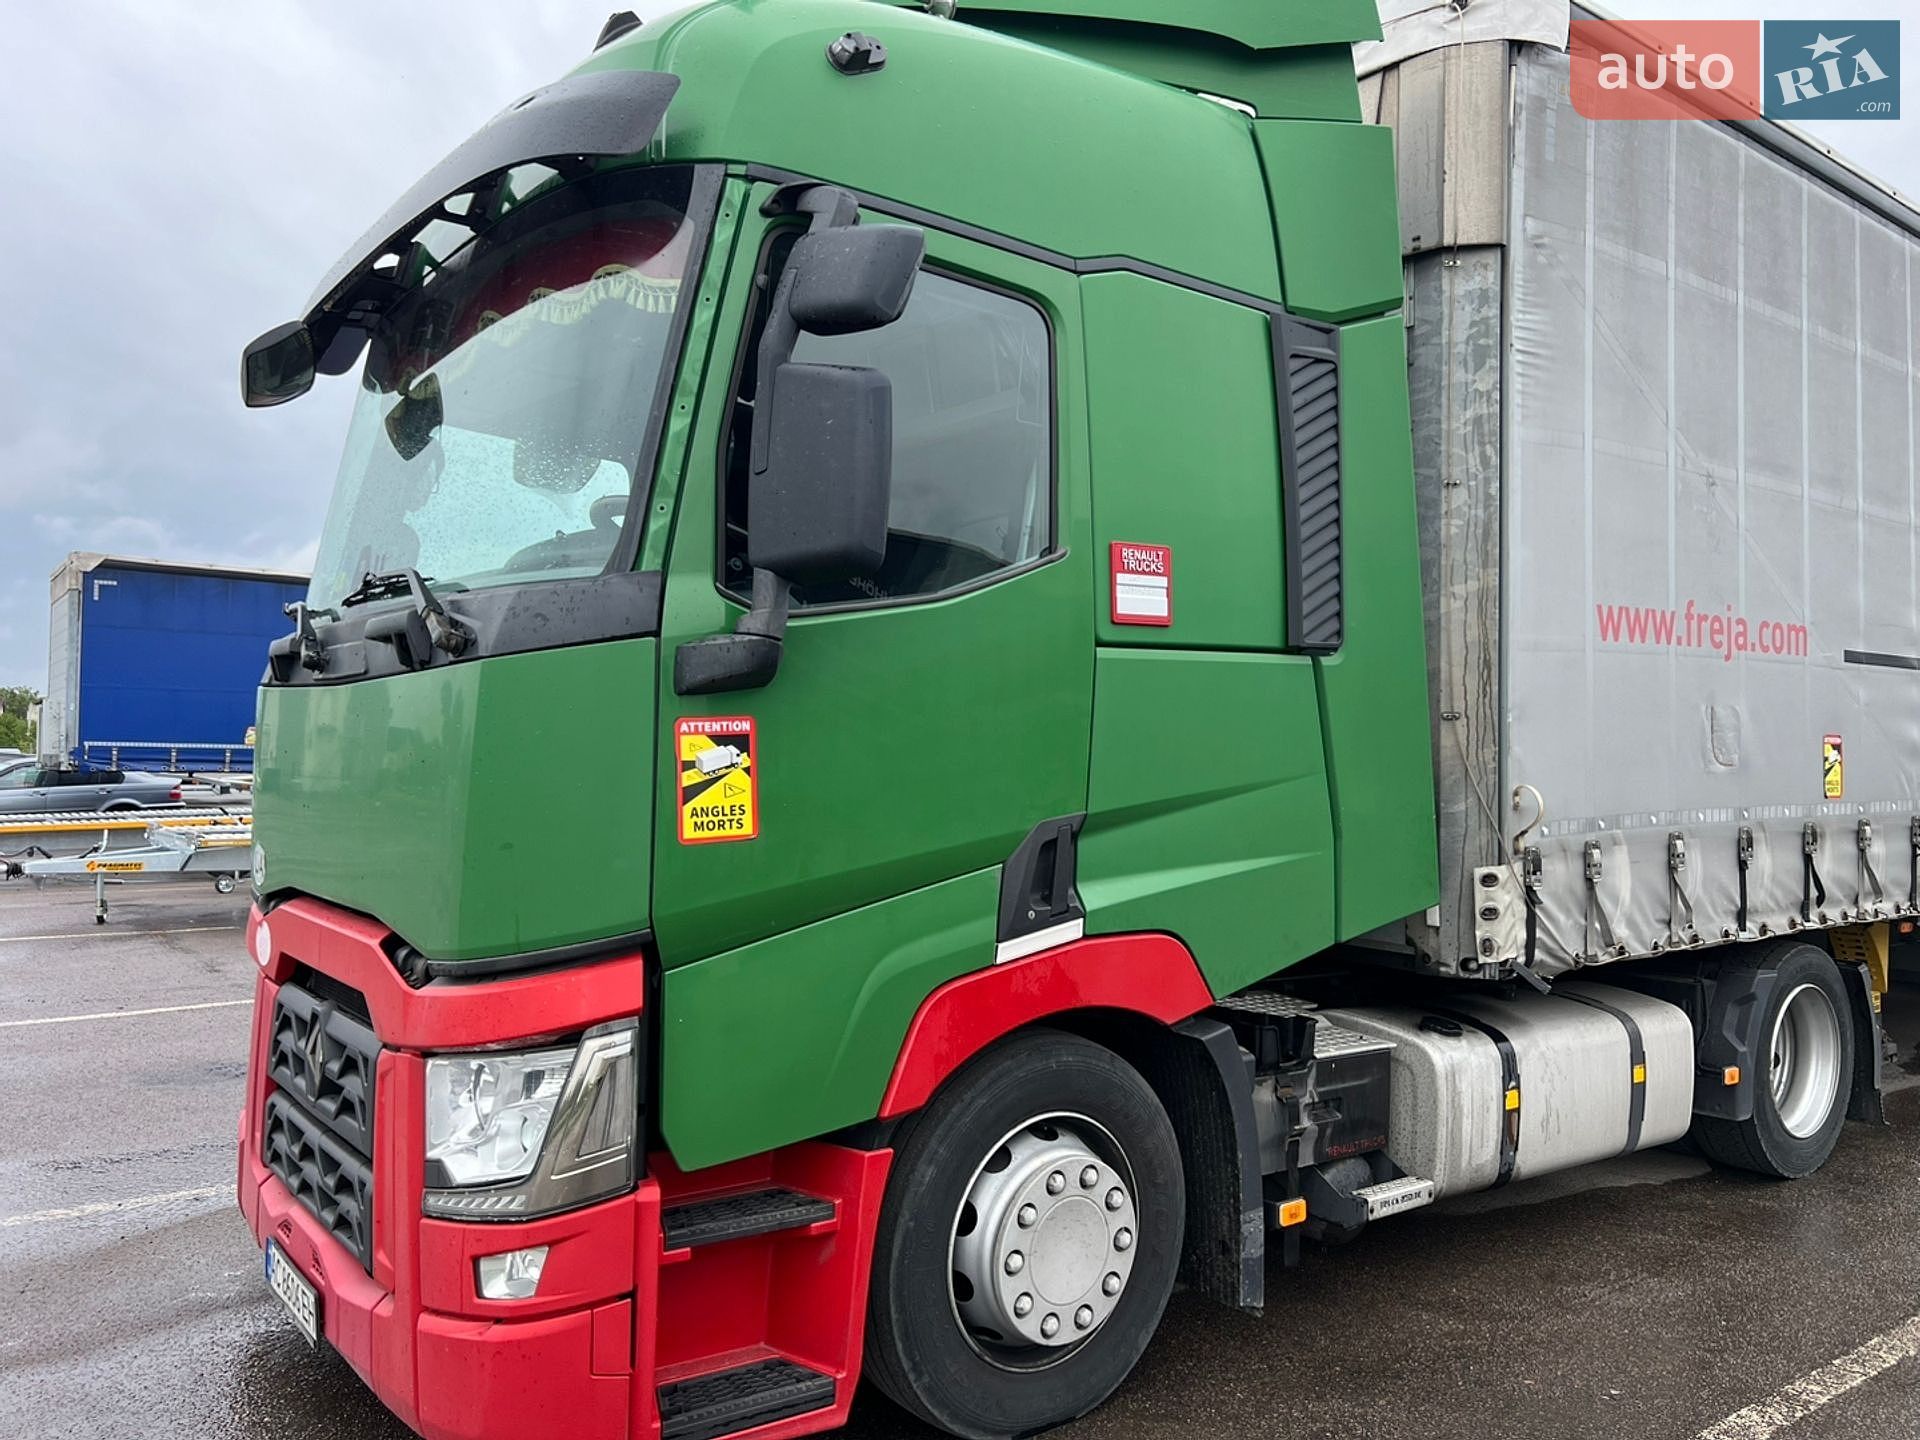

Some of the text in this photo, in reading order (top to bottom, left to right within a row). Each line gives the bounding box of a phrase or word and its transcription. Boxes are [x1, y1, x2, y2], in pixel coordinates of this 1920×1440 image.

[1122, 548, 1164, 562] RENAULT
[1122, 560, 1164, 573] TRUCKS
[1596, 599, 1808, 662] www.freja.com
[680, 721, 751, 733] ATTENTION
[690, 804, 746, 819] ANGLES
[693, 818, 744, 832] MORTS
